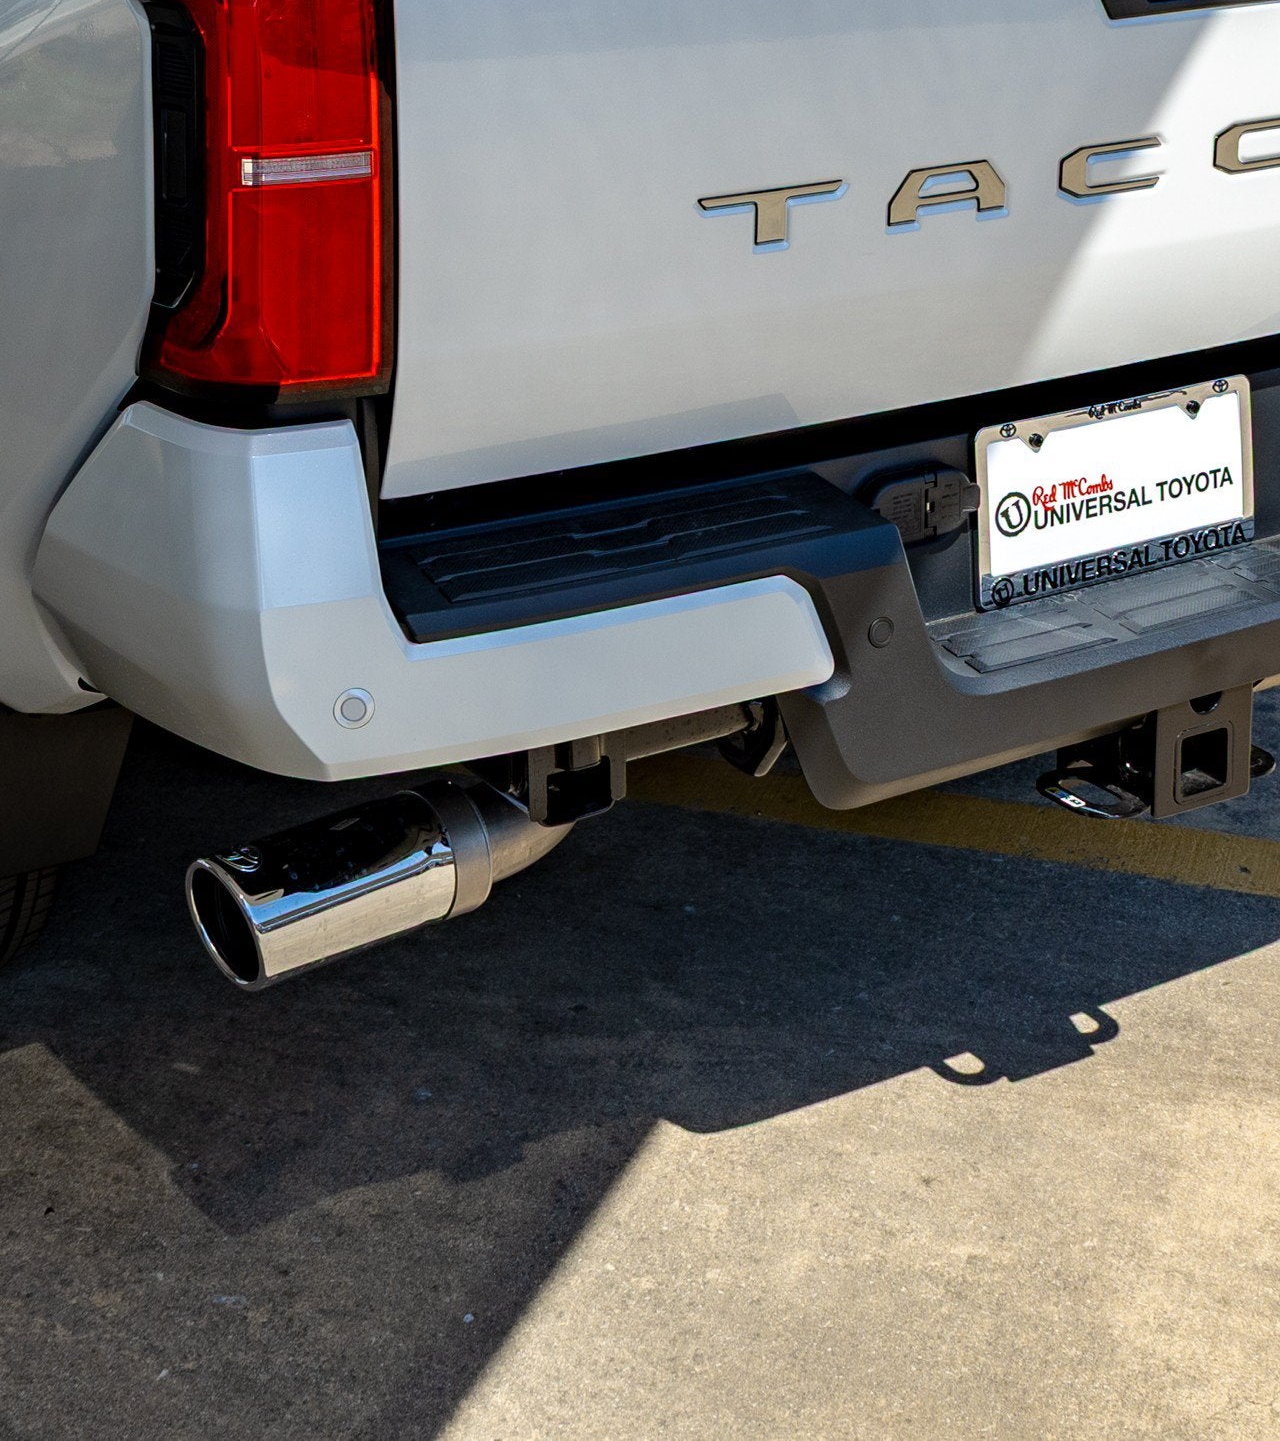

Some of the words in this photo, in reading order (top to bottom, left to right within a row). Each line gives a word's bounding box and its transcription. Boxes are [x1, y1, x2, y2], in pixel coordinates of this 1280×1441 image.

[1032, 483, 1058, 511] Red
[1058, 473, 1114, 500] McCombs
[1033, 485, 1153, 530] UNIVERSAL
[1155, 466, 1234, 502] TOYOTA
[1022, 544, 1158, 596] UNIVERSAL
[1159, 521, 1248, 560] TOYOTA
